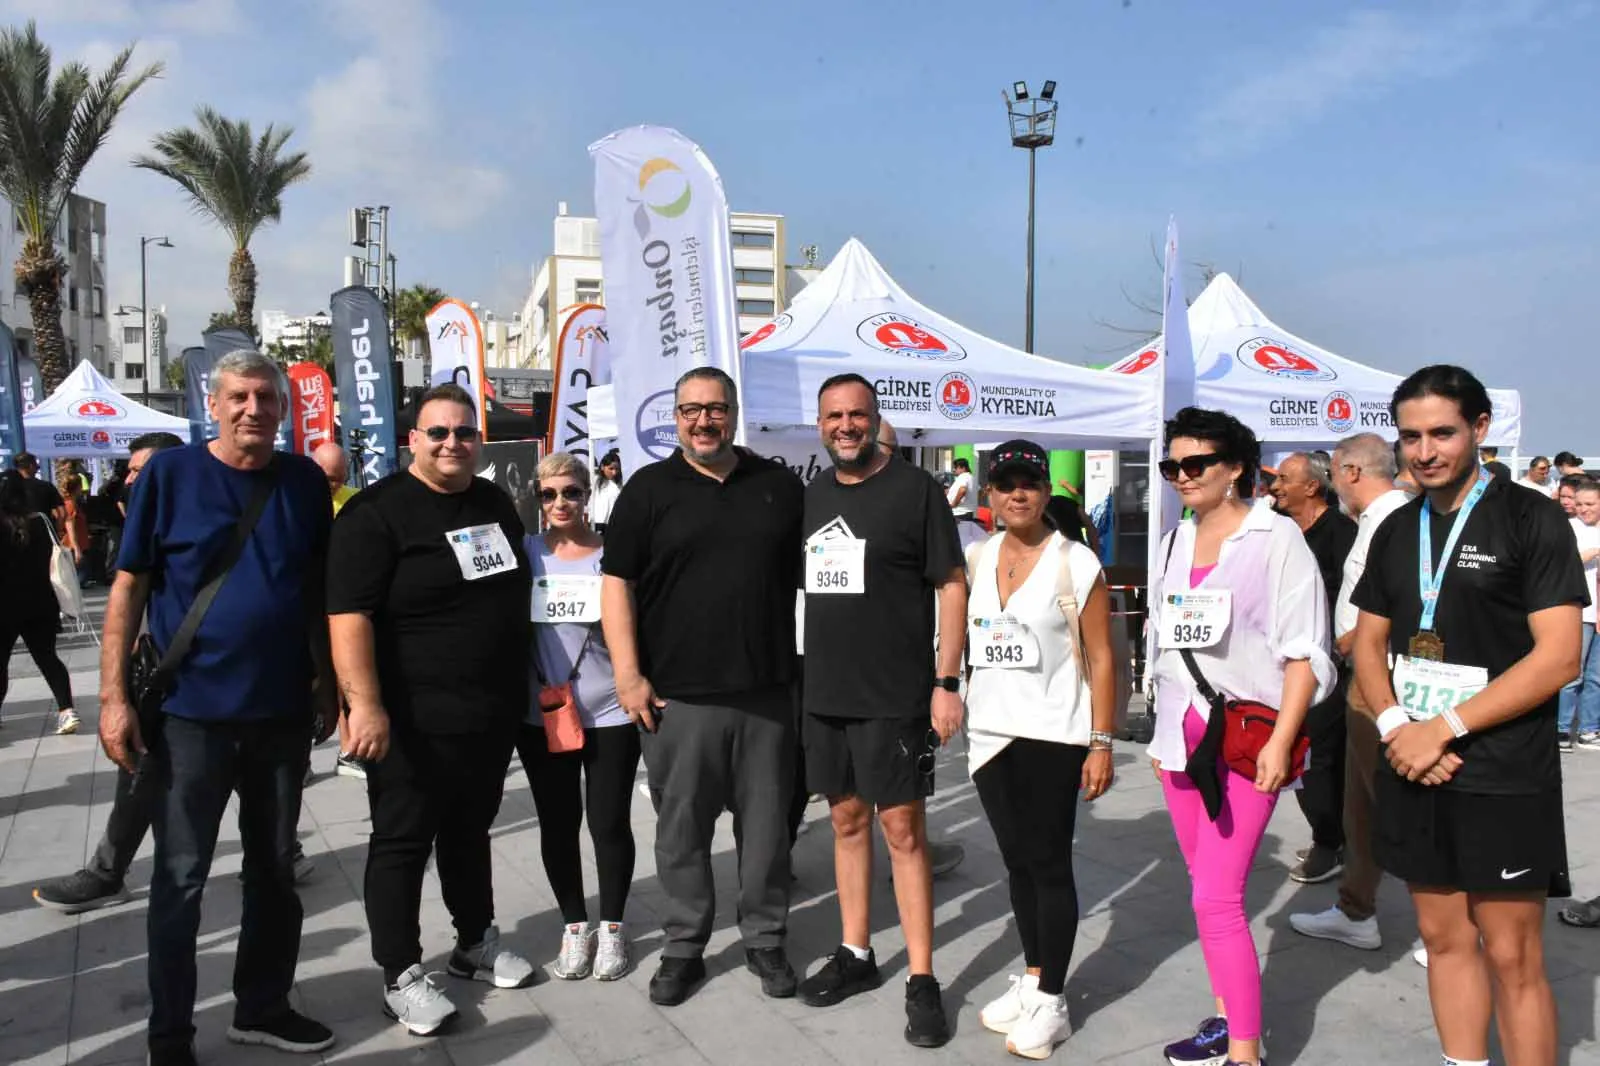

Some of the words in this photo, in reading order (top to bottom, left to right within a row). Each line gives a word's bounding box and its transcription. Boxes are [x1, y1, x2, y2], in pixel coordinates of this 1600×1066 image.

[875, 376, 931, 398] GİRNE
[981, 385, 1044, 398] MUNICIPALITY
[1045, 388, 1057, 398] OF
[564, 369, 597, 457] YAP
[981, 397, 1056, 417] KYRENIA
[1269, 396, 1318, 414] GİRNE
[472, 552, 505, 572] 9344
[1459, 552, 1497, 563] RUNNING
[817, 570, 849, 587] 9346
[546, 601, 586, 618] 9347
[1173, 624, 1213, 643] 9345
[985, 644, 1023, 663] 9343
